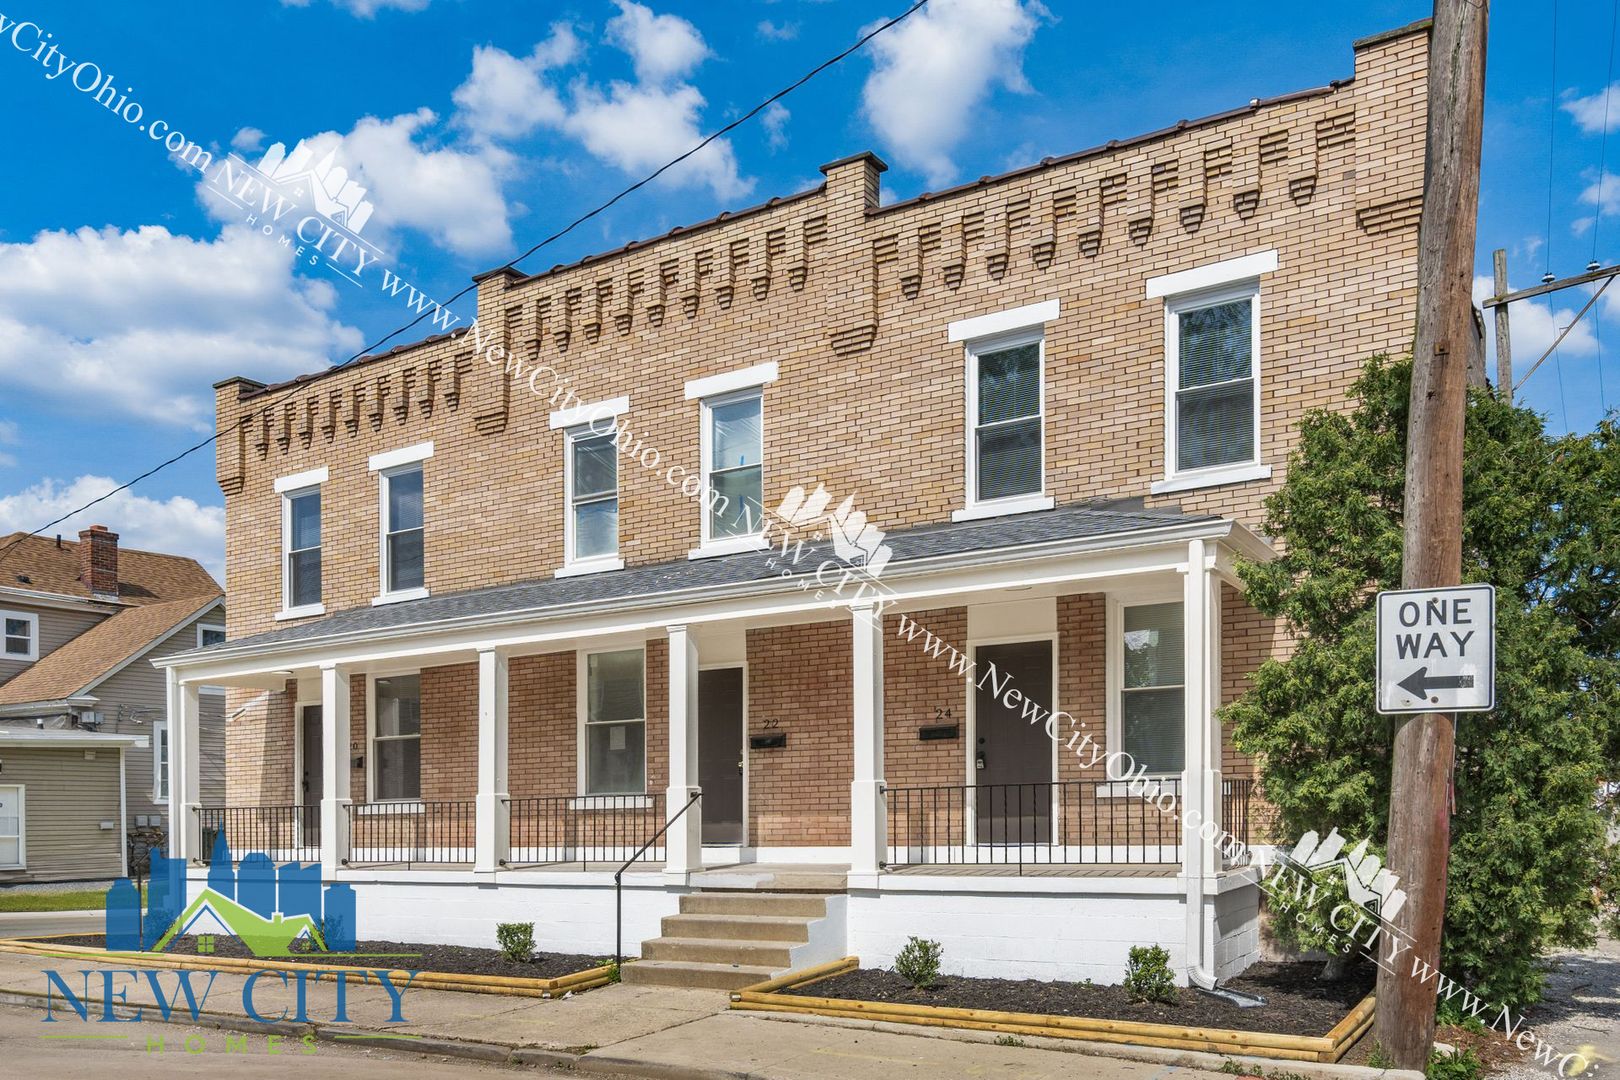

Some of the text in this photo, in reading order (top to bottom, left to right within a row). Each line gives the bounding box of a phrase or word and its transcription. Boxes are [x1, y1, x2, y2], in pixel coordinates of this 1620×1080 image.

[1399, 598, 1472, 628] ONE
[1396, 630, 1475, 660] WAY
[763, 719, 779, 729] 22
[935, 709, 952, 720] 24
